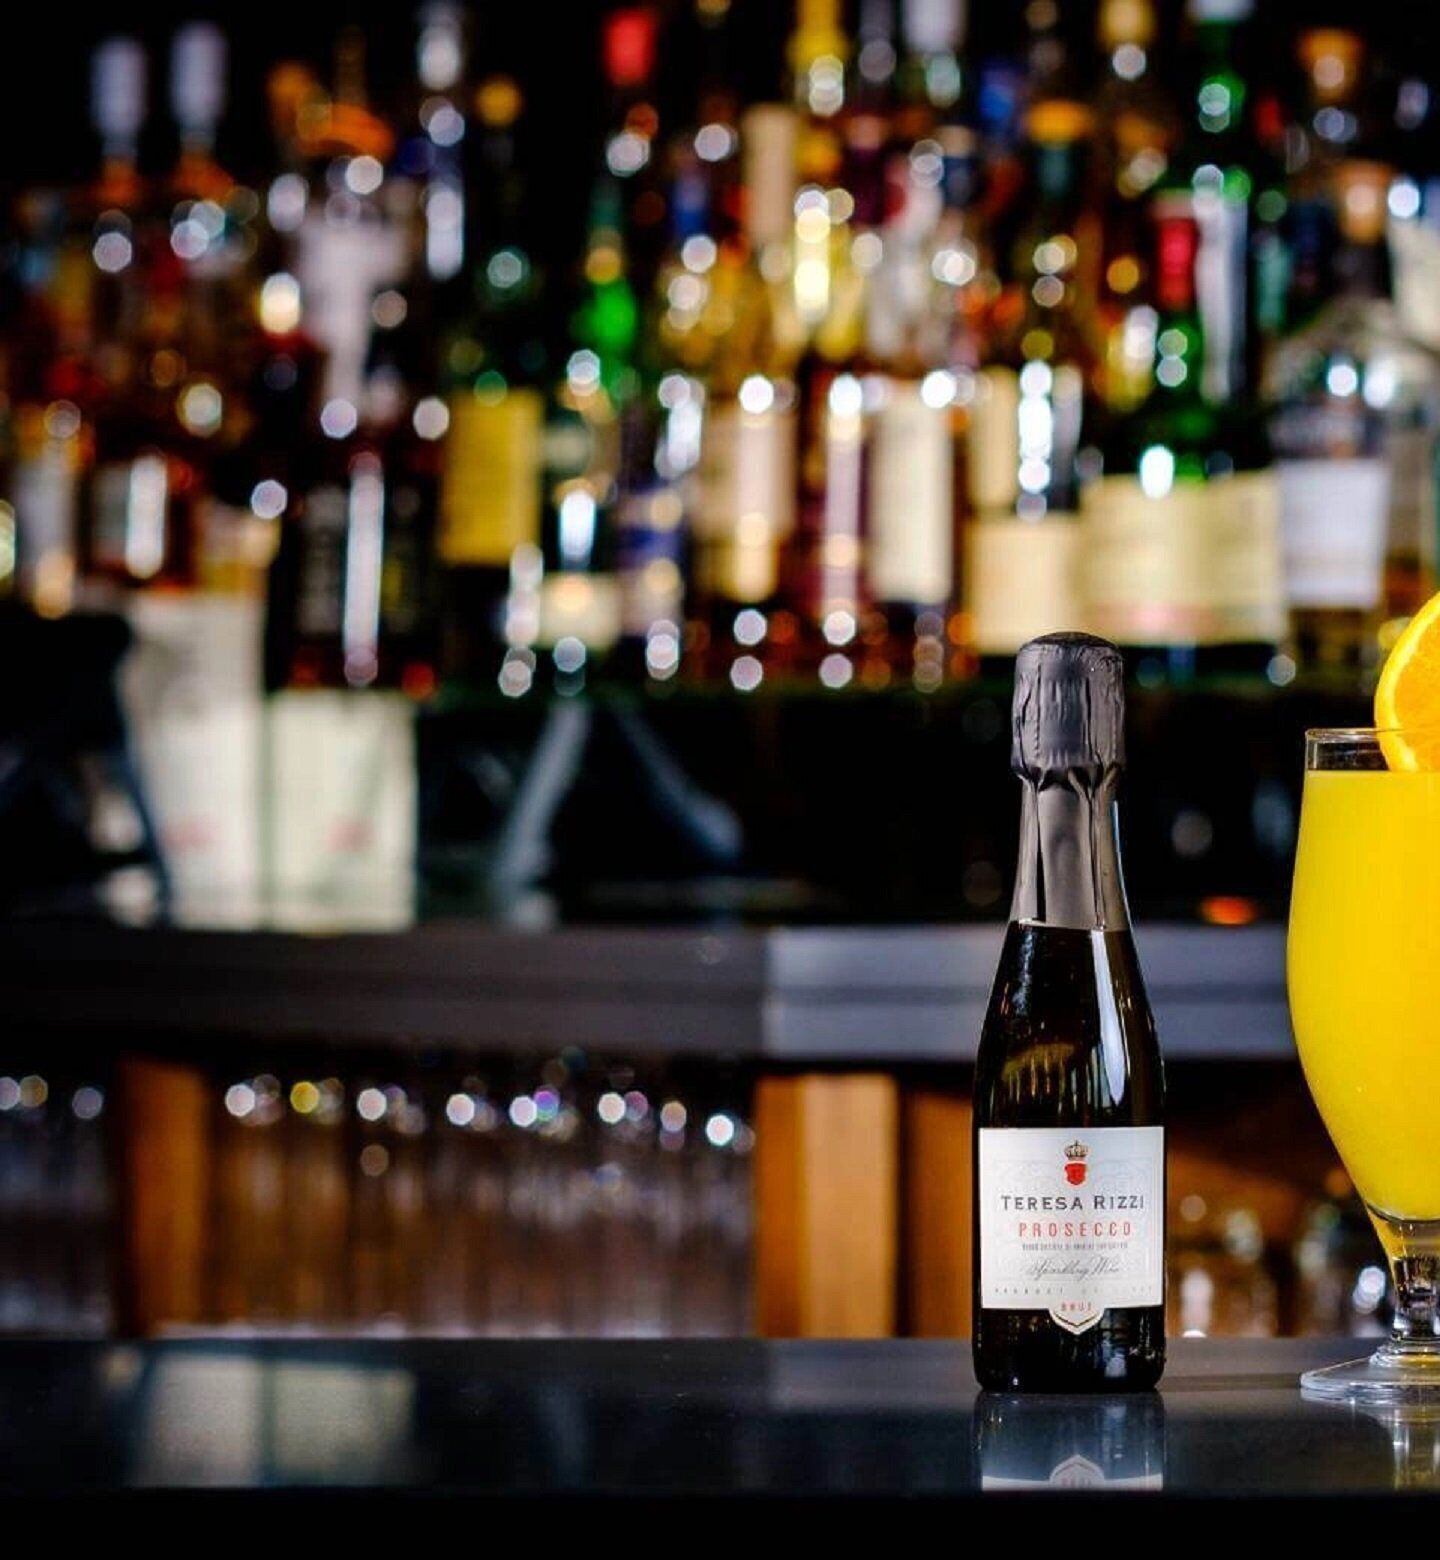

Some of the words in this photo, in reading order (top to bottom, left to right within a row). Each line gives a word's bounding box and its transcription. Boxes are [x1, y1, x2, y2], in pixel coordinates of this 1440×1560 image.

[1001, 1196, 1083, 1210] TERESA
[1094, 1195, 1144, 1209] RIZZI
[1019, 1222, 1131, 1237] PROSECCO
